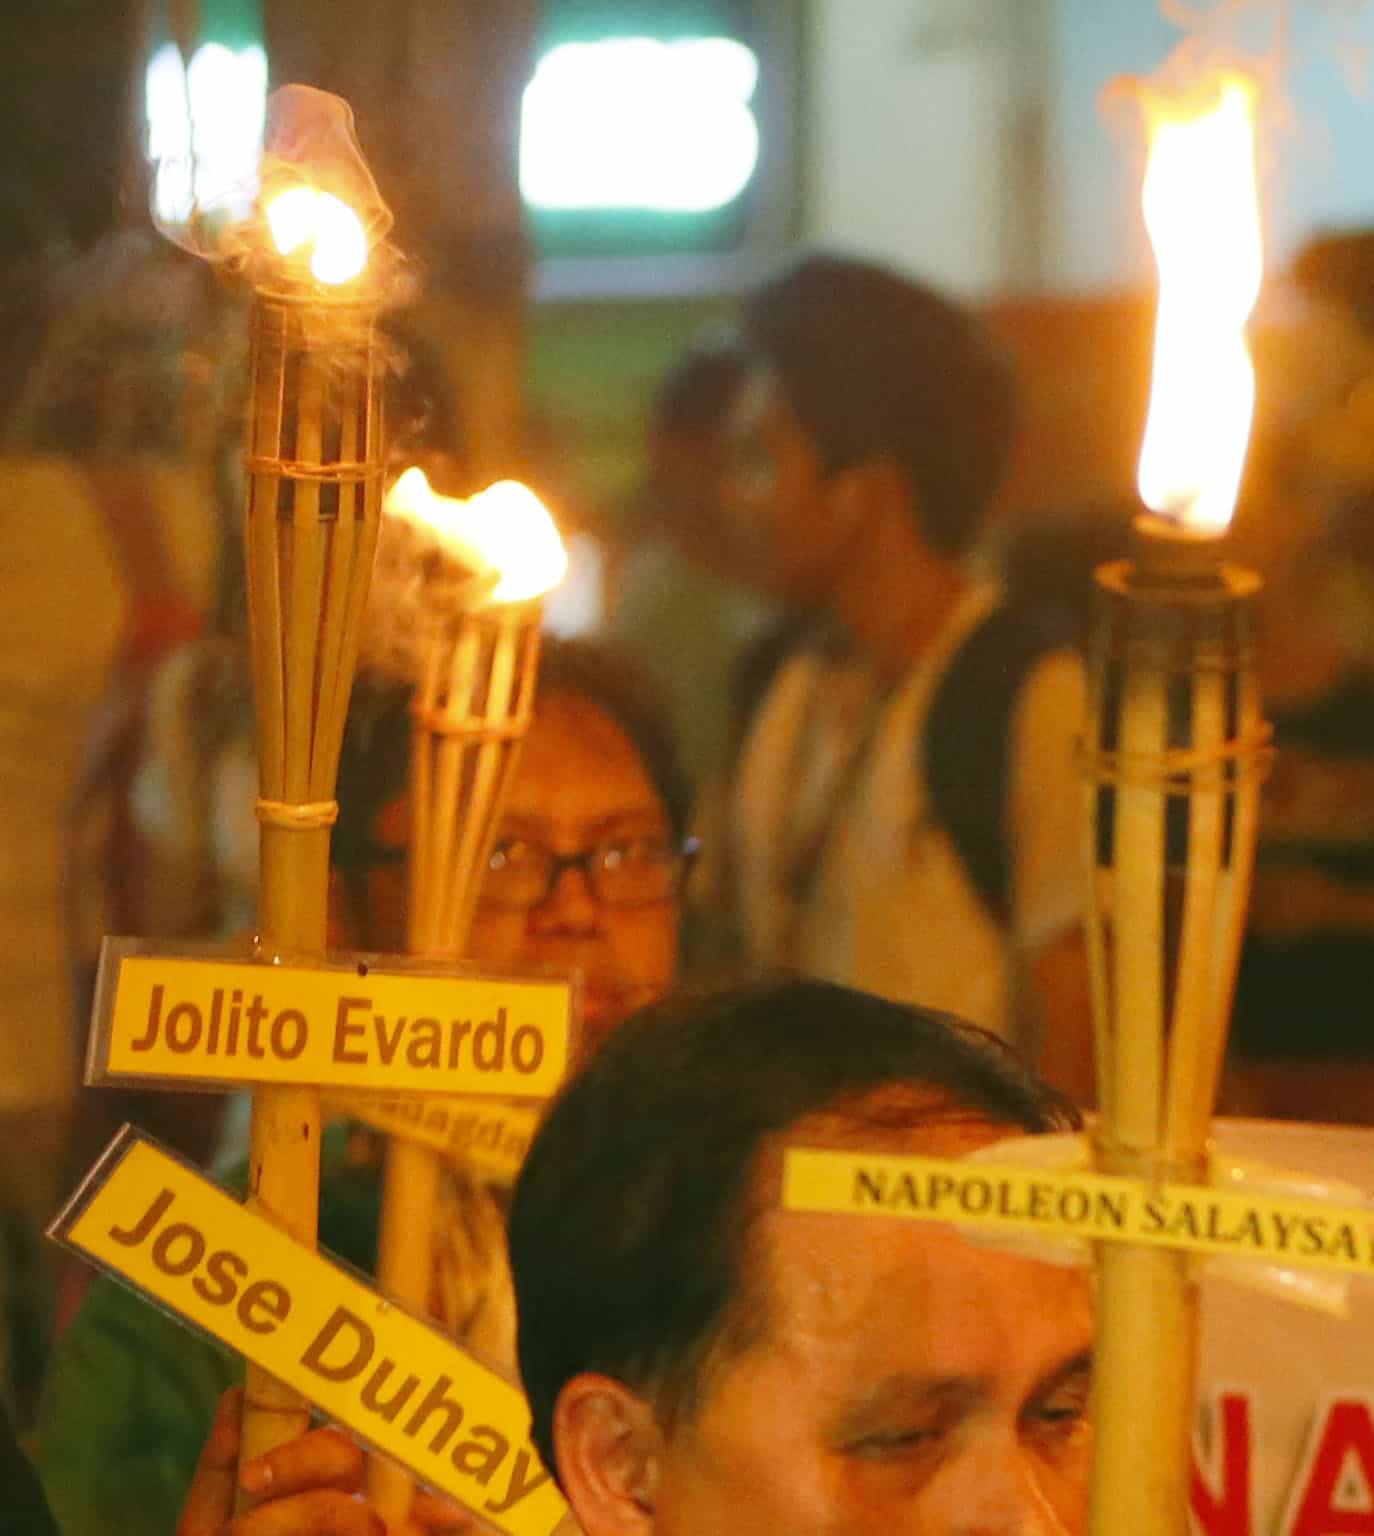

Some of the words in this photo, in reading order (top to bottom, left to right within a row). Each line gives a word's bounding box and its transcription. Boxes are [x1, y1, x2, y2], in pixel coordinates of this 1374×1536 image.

[130, 984, 309, 1060] Jolito
[332, 995, 546, 1077] Evardo
[852, 1167, 1126, 1230] NAPOLEON
[108, 1187, 292, 1336] Jose
[299, 1305, 554, 1513] Duhay
